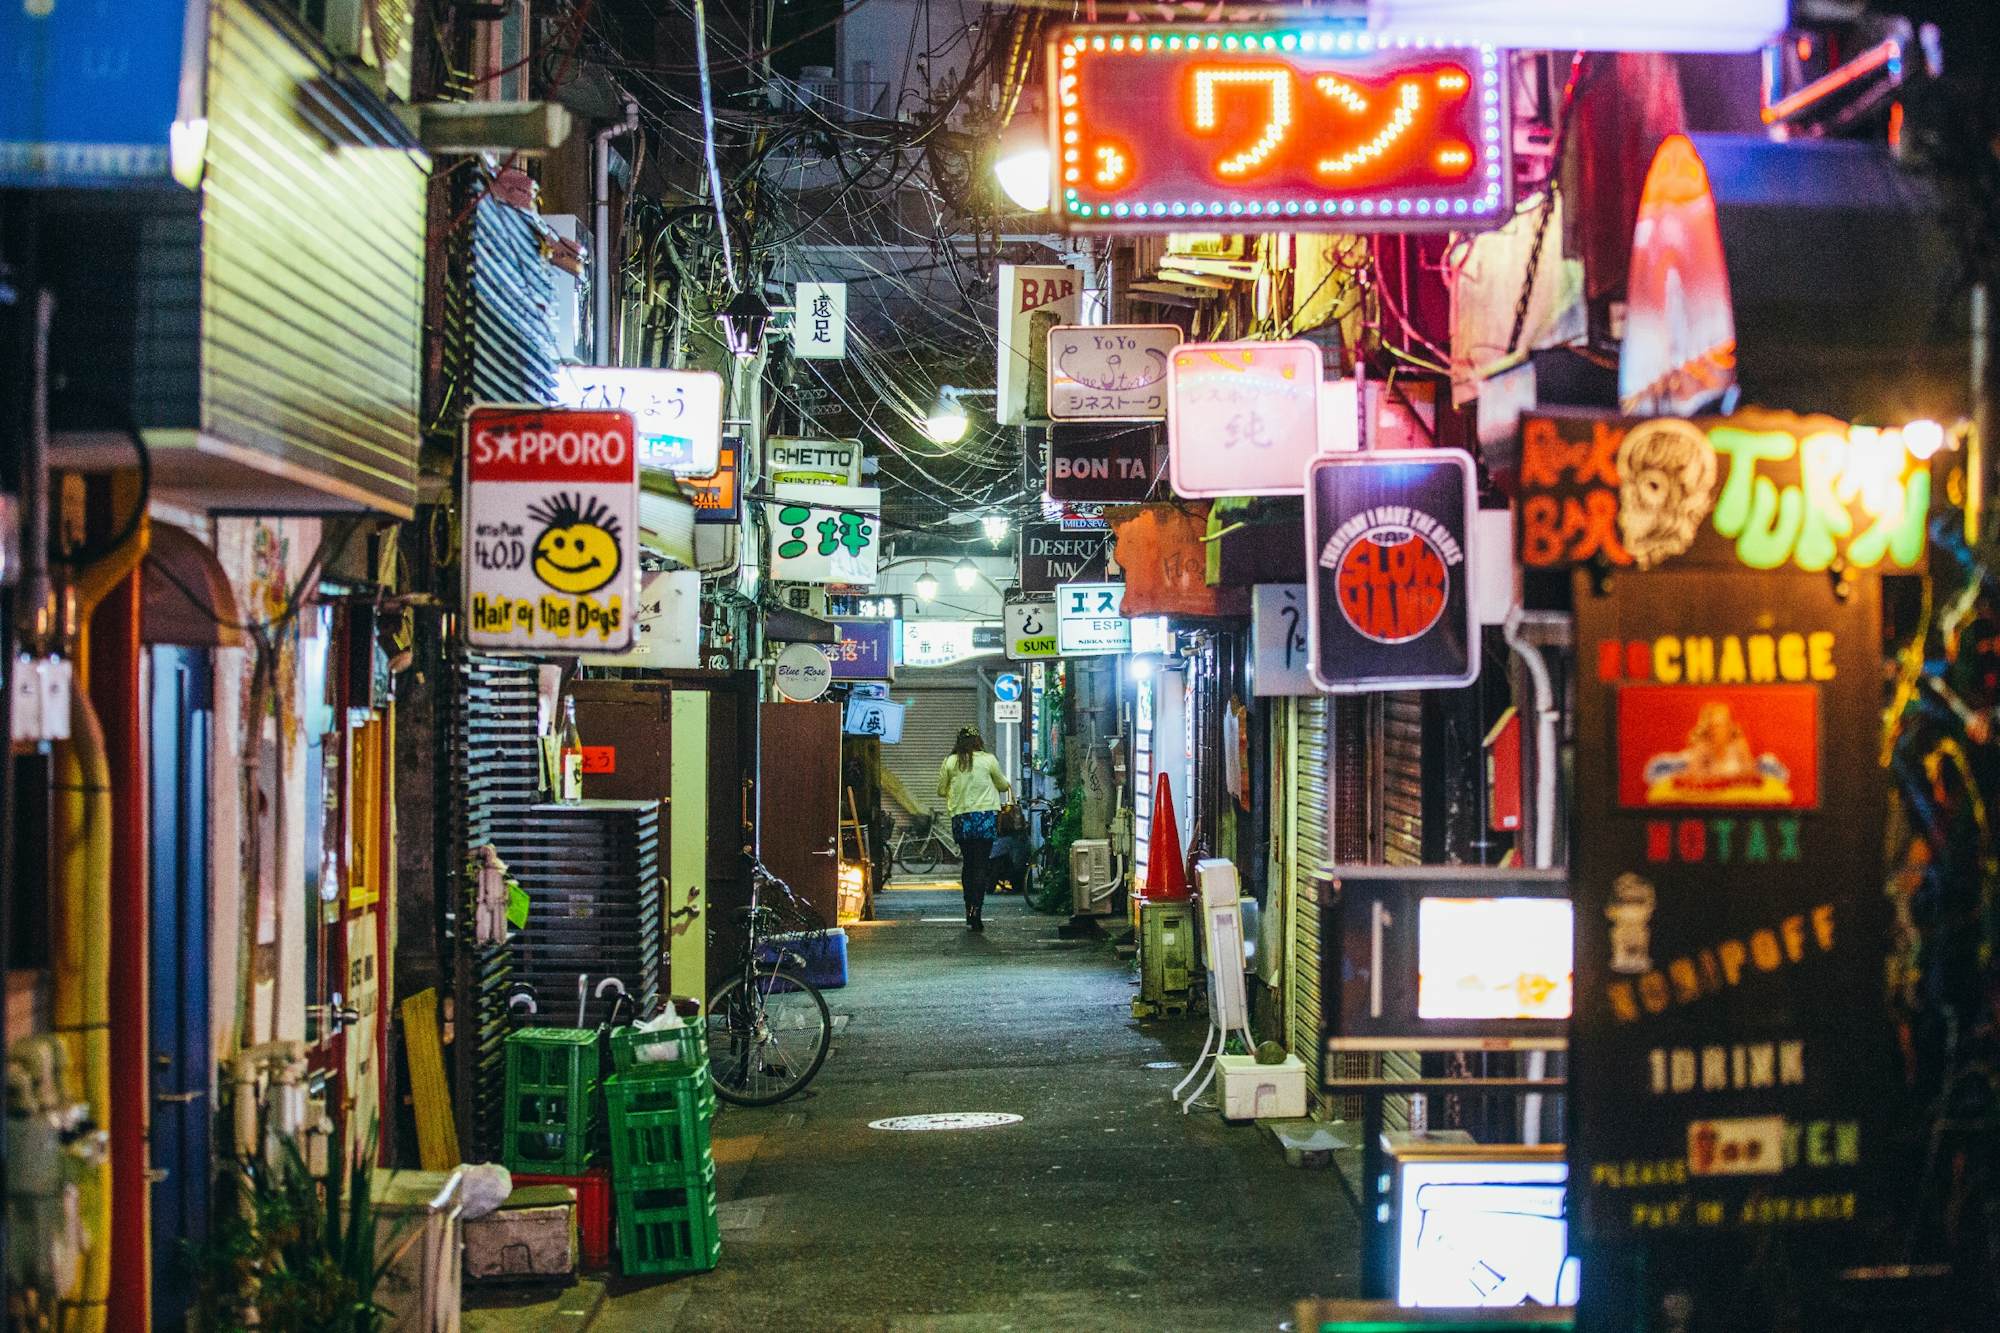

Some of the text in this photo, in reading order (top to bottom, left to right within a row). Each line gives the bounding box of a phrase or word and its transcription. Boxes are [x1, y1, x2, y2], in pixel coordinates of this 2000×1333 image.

[1020, 278, 1074, 313] BAR
[812, 294, 831, 342] 遠足
[1069, 396, 1161, 409] シネストーク
[774, 448, 851, 467] GHETTO
[1055, 457, 1146, 480] BON TA
[1030, 479, 1044, 488] 2F
[1065, 519, 1087, 528] MILD
[1522, 488, 1634, 566] BAR
[1375, 506, 1412, 526] HAVE
[1411, 509, 1438, 535] THE
[1430, 525, 1464, 567] BLUES
[1030, 538, 1096, 560] DESERT
[1047, 560, 1077, 578] INN
[1340, 537, 1445, 589] SLOW
[474, 596, 620, 635] Hair of the Dogs
[1093, 621, 1122, 630] ESP
[1654, 631, 1837, 683] CHARGE
[779, 665, 826, 676] Blue Rose
[1714, 818, 1800, 862] TAX
